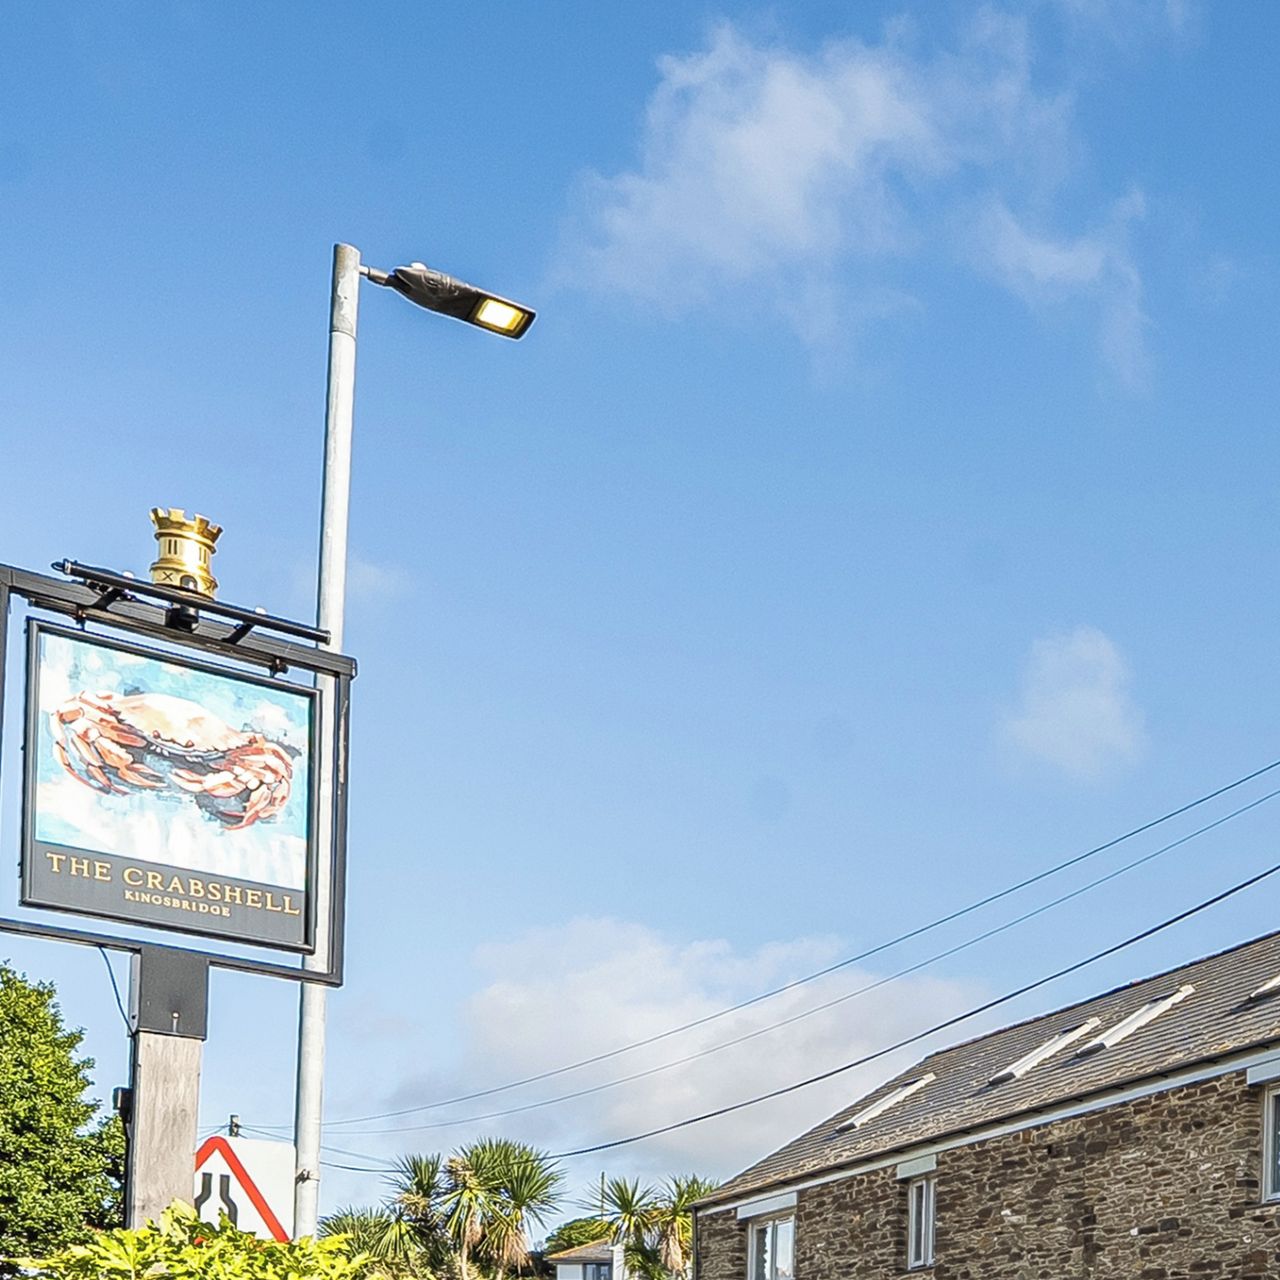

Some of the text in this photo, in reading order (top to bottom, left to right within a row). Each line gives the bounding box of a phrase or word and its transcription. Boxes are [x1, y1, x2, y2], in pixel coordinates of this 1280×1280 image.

[46, 852, 301, 916] THE CRABSHELL
[123, 889, 232, 918] KINGSBRIDGE
